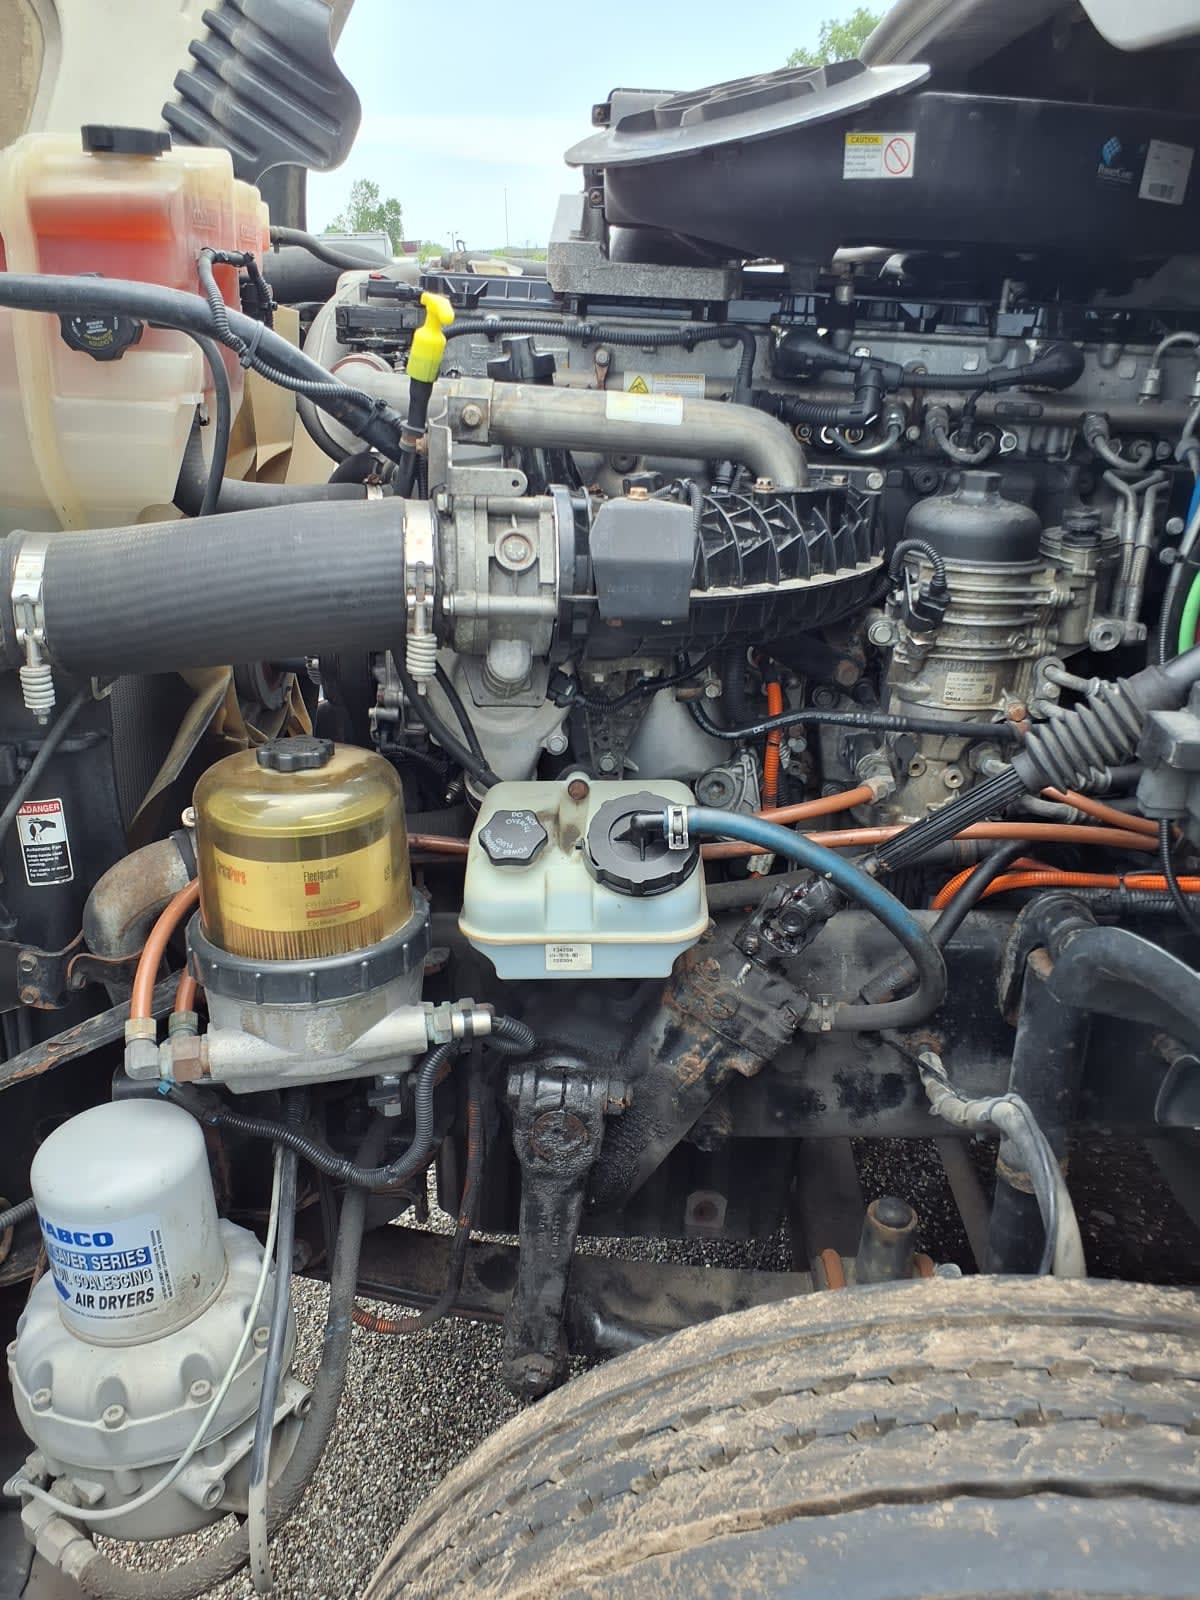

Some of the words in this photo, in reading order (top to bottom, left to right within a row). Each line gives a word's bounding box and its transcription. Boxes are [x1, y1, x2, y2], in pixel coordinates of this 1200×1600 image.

[850, 135, 880, 144] CAUTION
[26, 803, 60, 813] DANGER
[303, 866, 339, 883] Fleetguard
[53, 1246, 89, 1270] SAVER
[91, 1248, 146, 1270] SERIES
[74, 1268, 153, 1290] COALESCING
[75, 1292, 95, 1309] AIR
[99, 1287, 154, 1310] DRYERS
